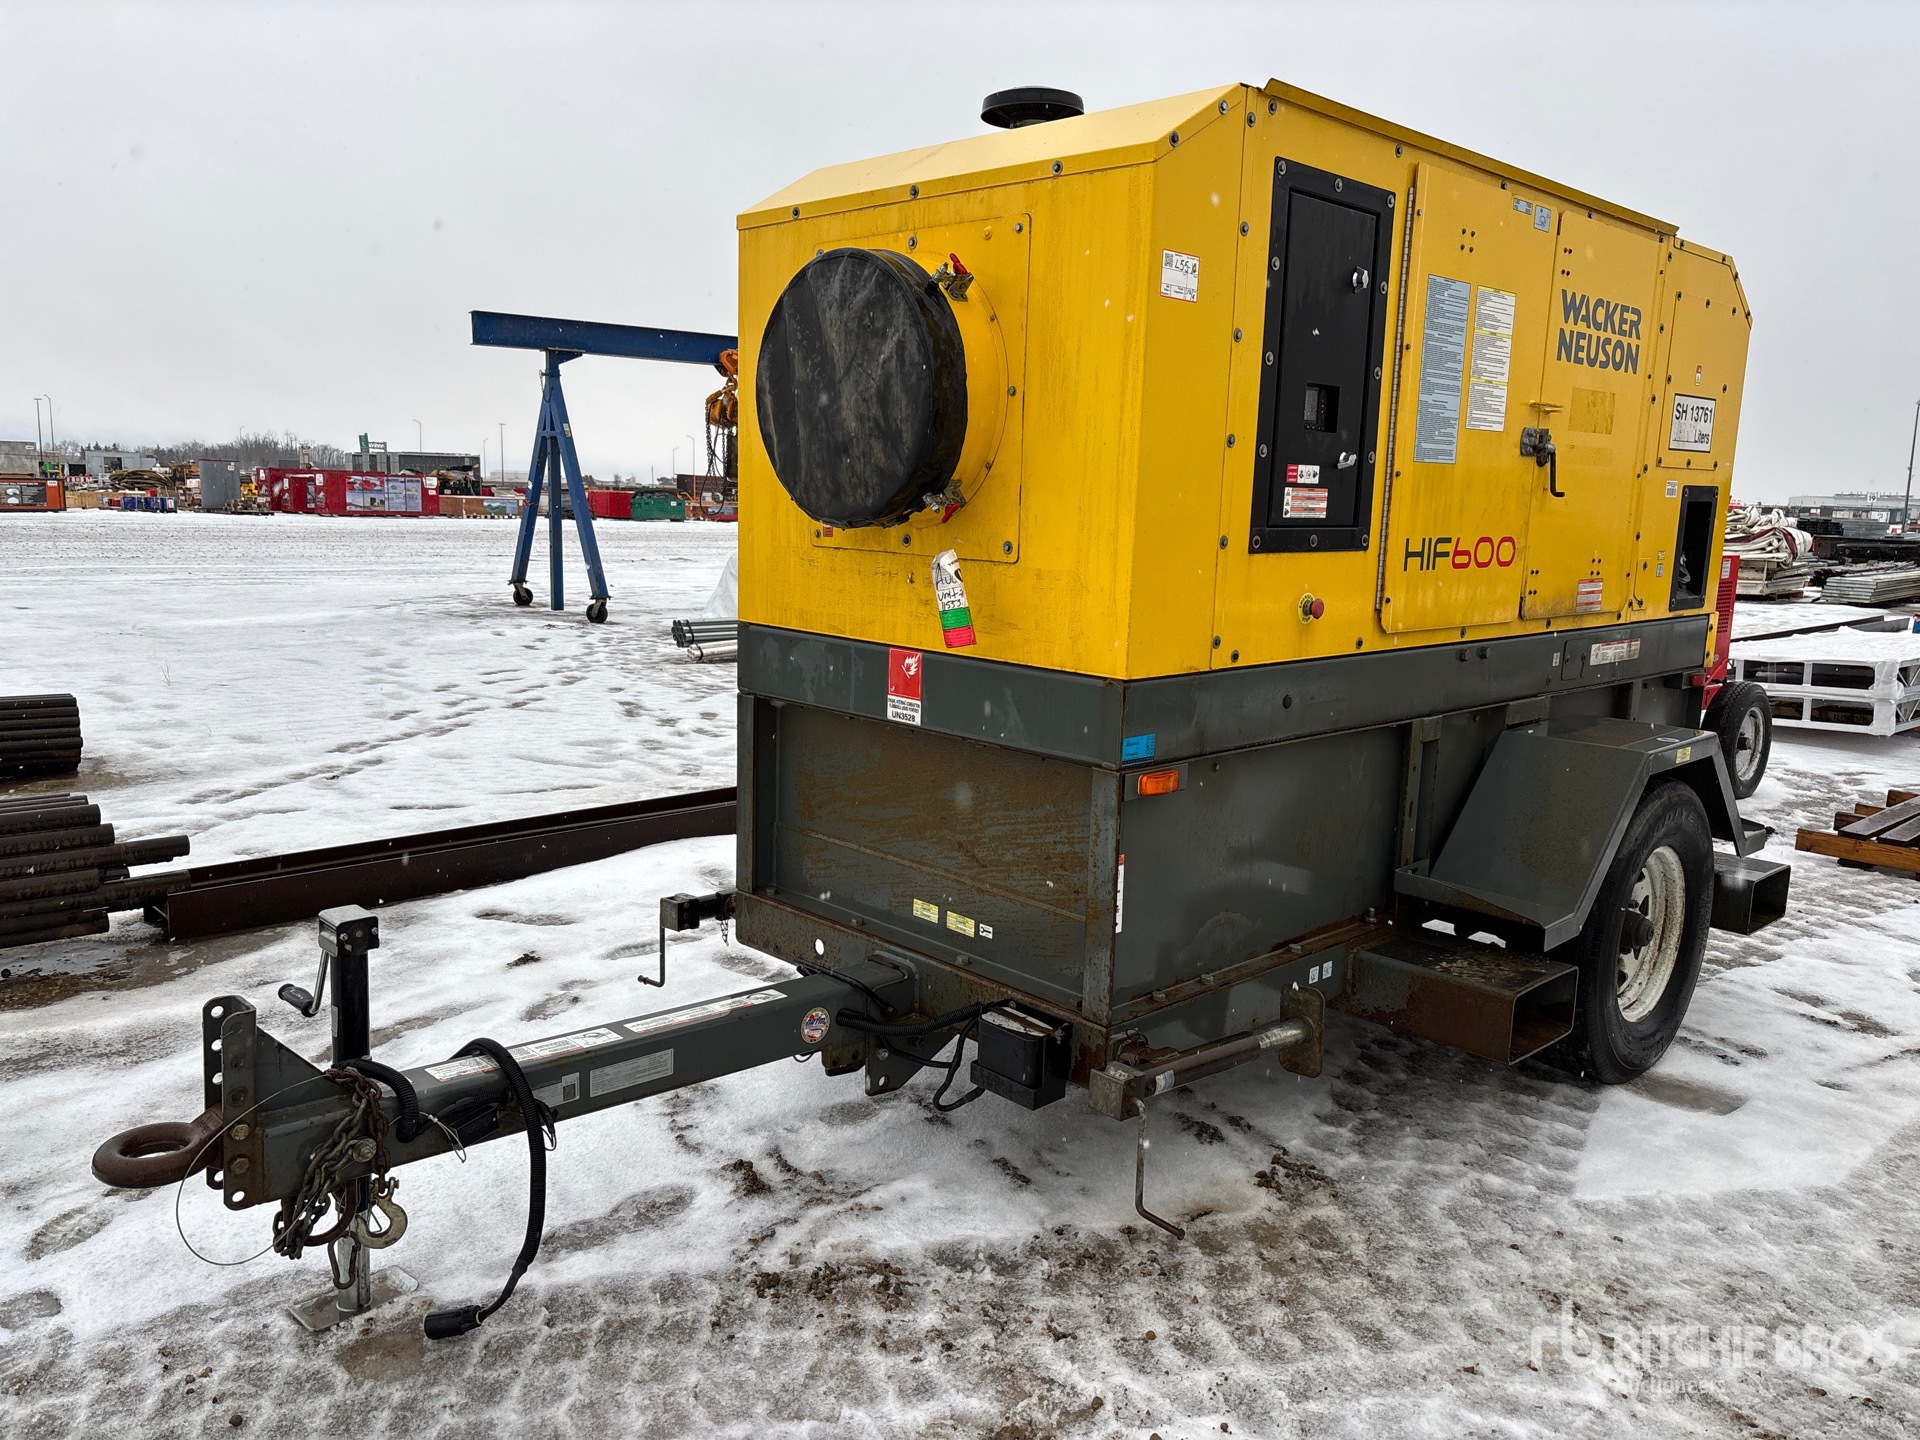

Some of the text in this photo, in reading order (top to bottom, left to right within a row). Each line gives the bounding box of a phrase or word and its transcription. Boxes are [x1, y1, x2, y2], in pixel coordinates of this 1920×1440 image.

[1561, 289, 1642, 340] WACKER
[1556, 328, 1640, 375] NEUSON
[1675, 403, 1713, 424] SH 13761
[1693, 430, 1710, 445] Liters
[1403, 536, 1517, 571] HIF600
[892, 710, 915, 722] UN3528
